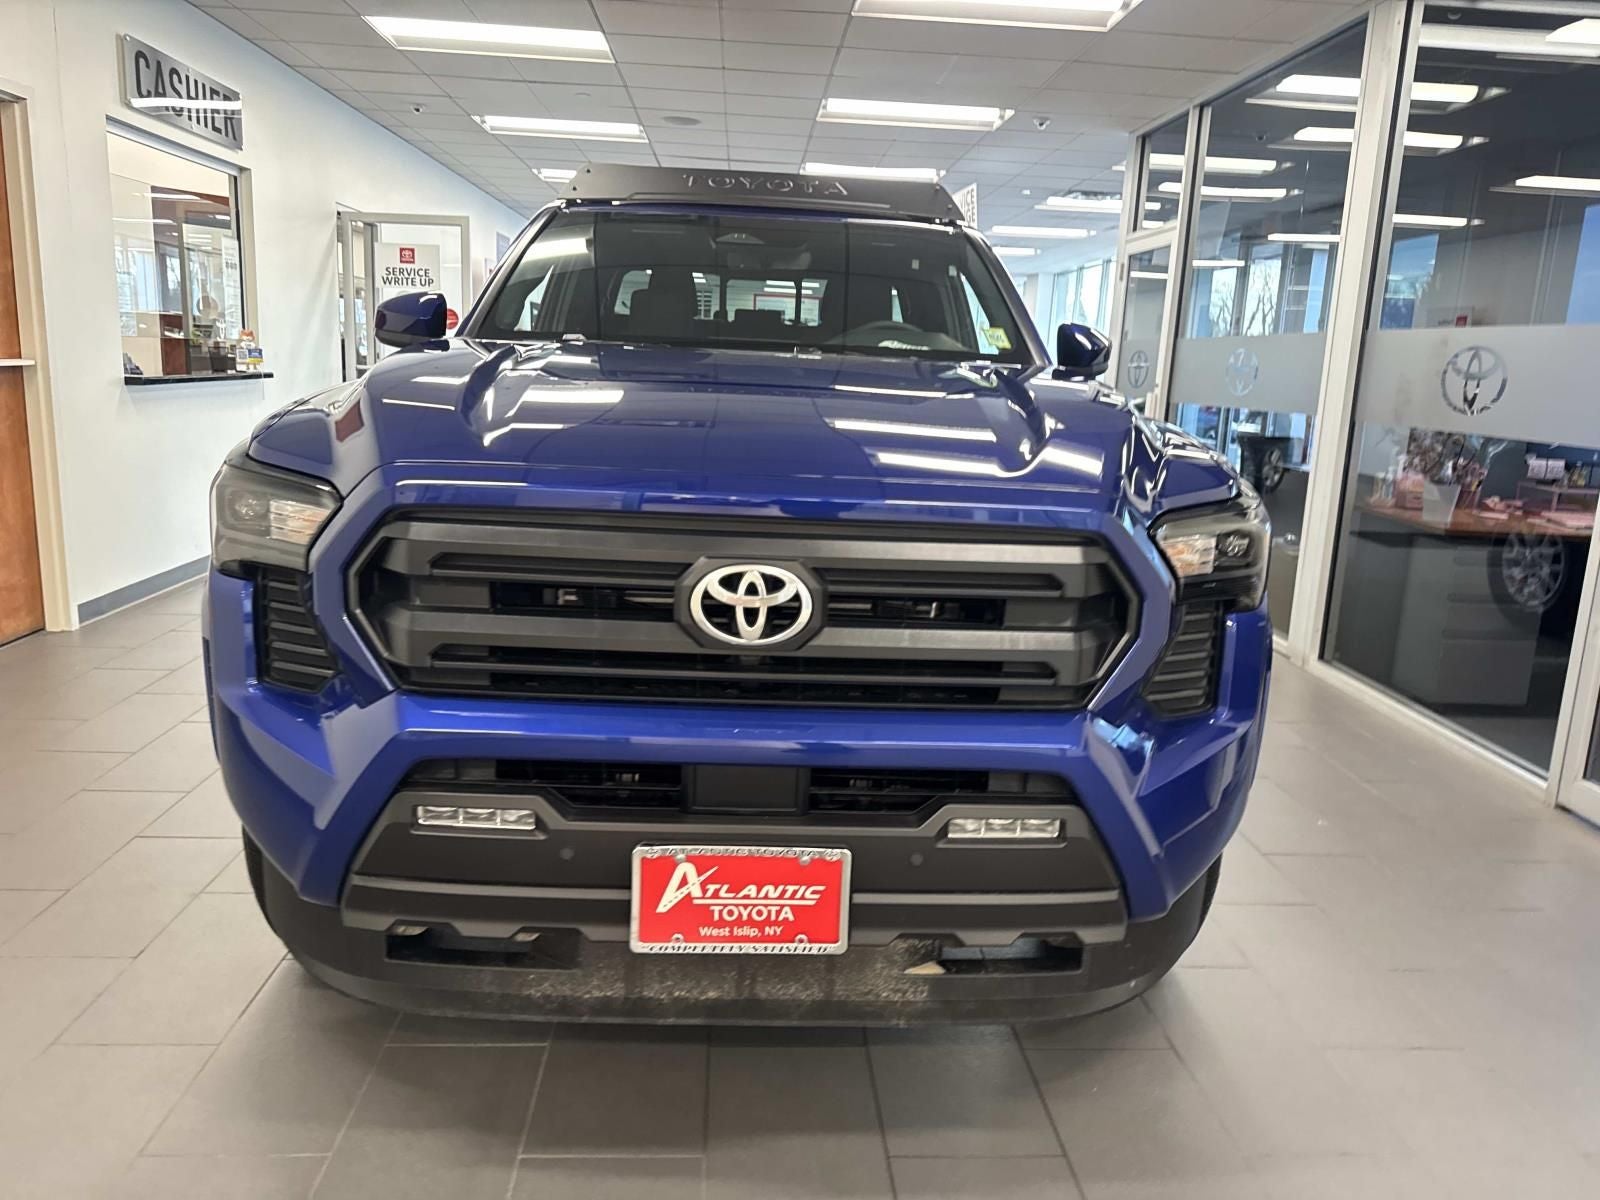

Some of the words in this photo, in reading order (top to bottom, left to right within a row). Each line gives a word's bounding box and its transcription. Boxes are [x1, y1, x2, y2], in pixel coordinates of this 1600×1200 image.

[134, 49, 238, 142] CASHIER
[682, 174, 849, 196] TOYOTA
[385, 266, 431, 278] SERVICE
[381, 276, 418, 287] WRITE
[419, 278, 435, 288] UP
[709, 905, 796, 922] TOYOTA
[698, 926, 731, 937] West
[733, 926, 762, 938] Islip,
[764, 926, 784, 937] NY
